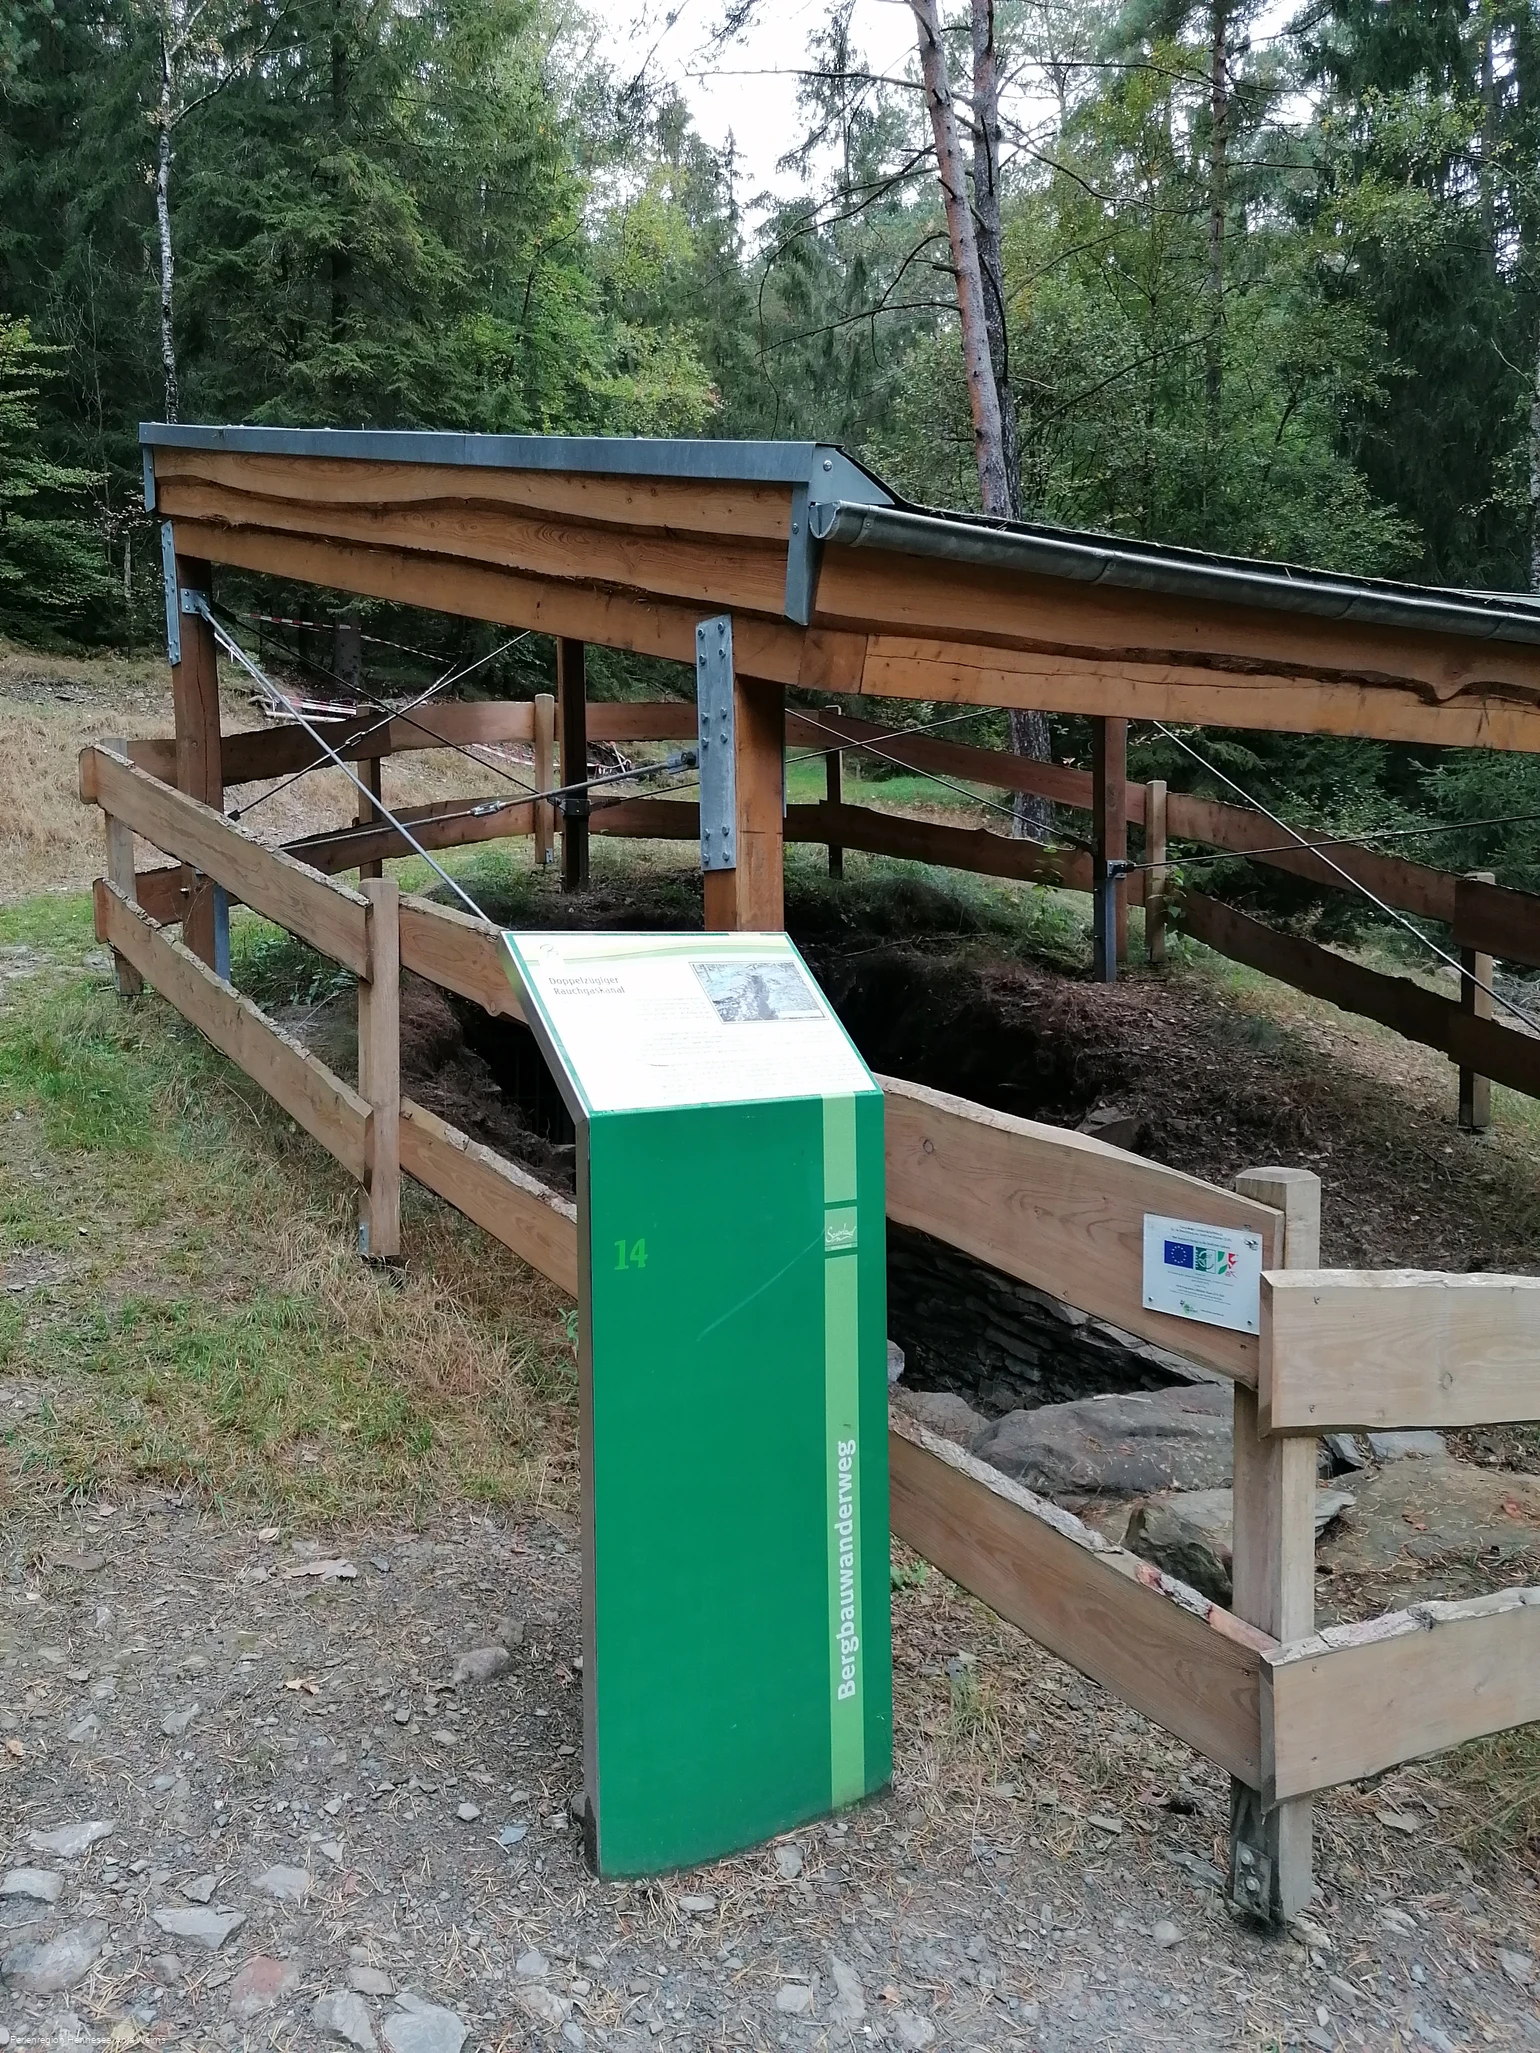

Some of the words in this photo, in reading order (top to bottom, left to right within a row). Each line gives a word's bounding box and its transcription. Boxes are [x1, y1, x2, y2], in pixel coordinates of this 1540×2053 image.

[548, 976, 619, 986] Doppelzügiger
[553, 986, 626, 996] Rauchgaskanal
[614, 1238, 648, 1270] 14
[834, 1439, 859, 1701] Bergbauwanderweg
